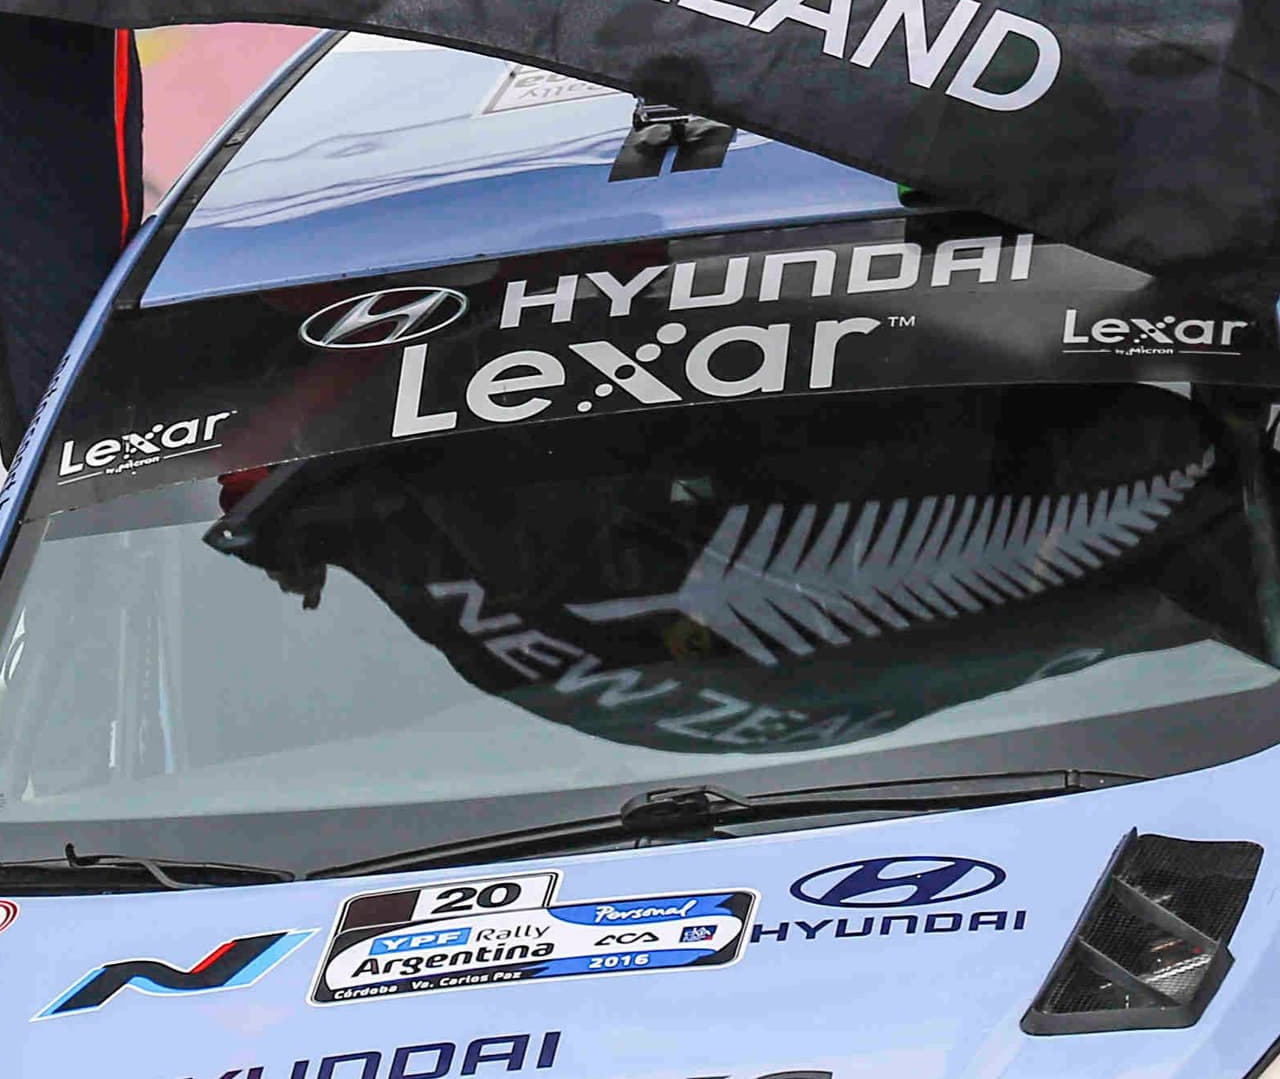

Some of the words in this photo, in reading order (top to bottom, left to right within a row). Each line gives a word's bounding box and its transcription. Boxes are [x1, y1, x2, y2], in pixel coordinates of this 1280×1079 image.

[500, 233, 1033, 330] HYUNDAI
[1062, 309, 1249, 346] Lexar
[391, 314, 882, 439] Lexar
[59, 410, 232, 476] Lexar
[430, 882, 522, 914] 20
[595, 899, 698, 923] Personal
[381, 932, 463, 951] YPF
[475, 924, 551, 942] Rally
[750, 910, 1027, 944] HYUNDAI
[351, 942, 555, 978] Argentina
[588, 953, 650, 969] 2016
[334, 984, 398, 1000] Córdoba
[411, 980, 434, 991] Va.
[439, 974, 489, 987] Carlos
[493, 970, 522, 982] Paz
[183, 1031, 562, 1079] NDAI
